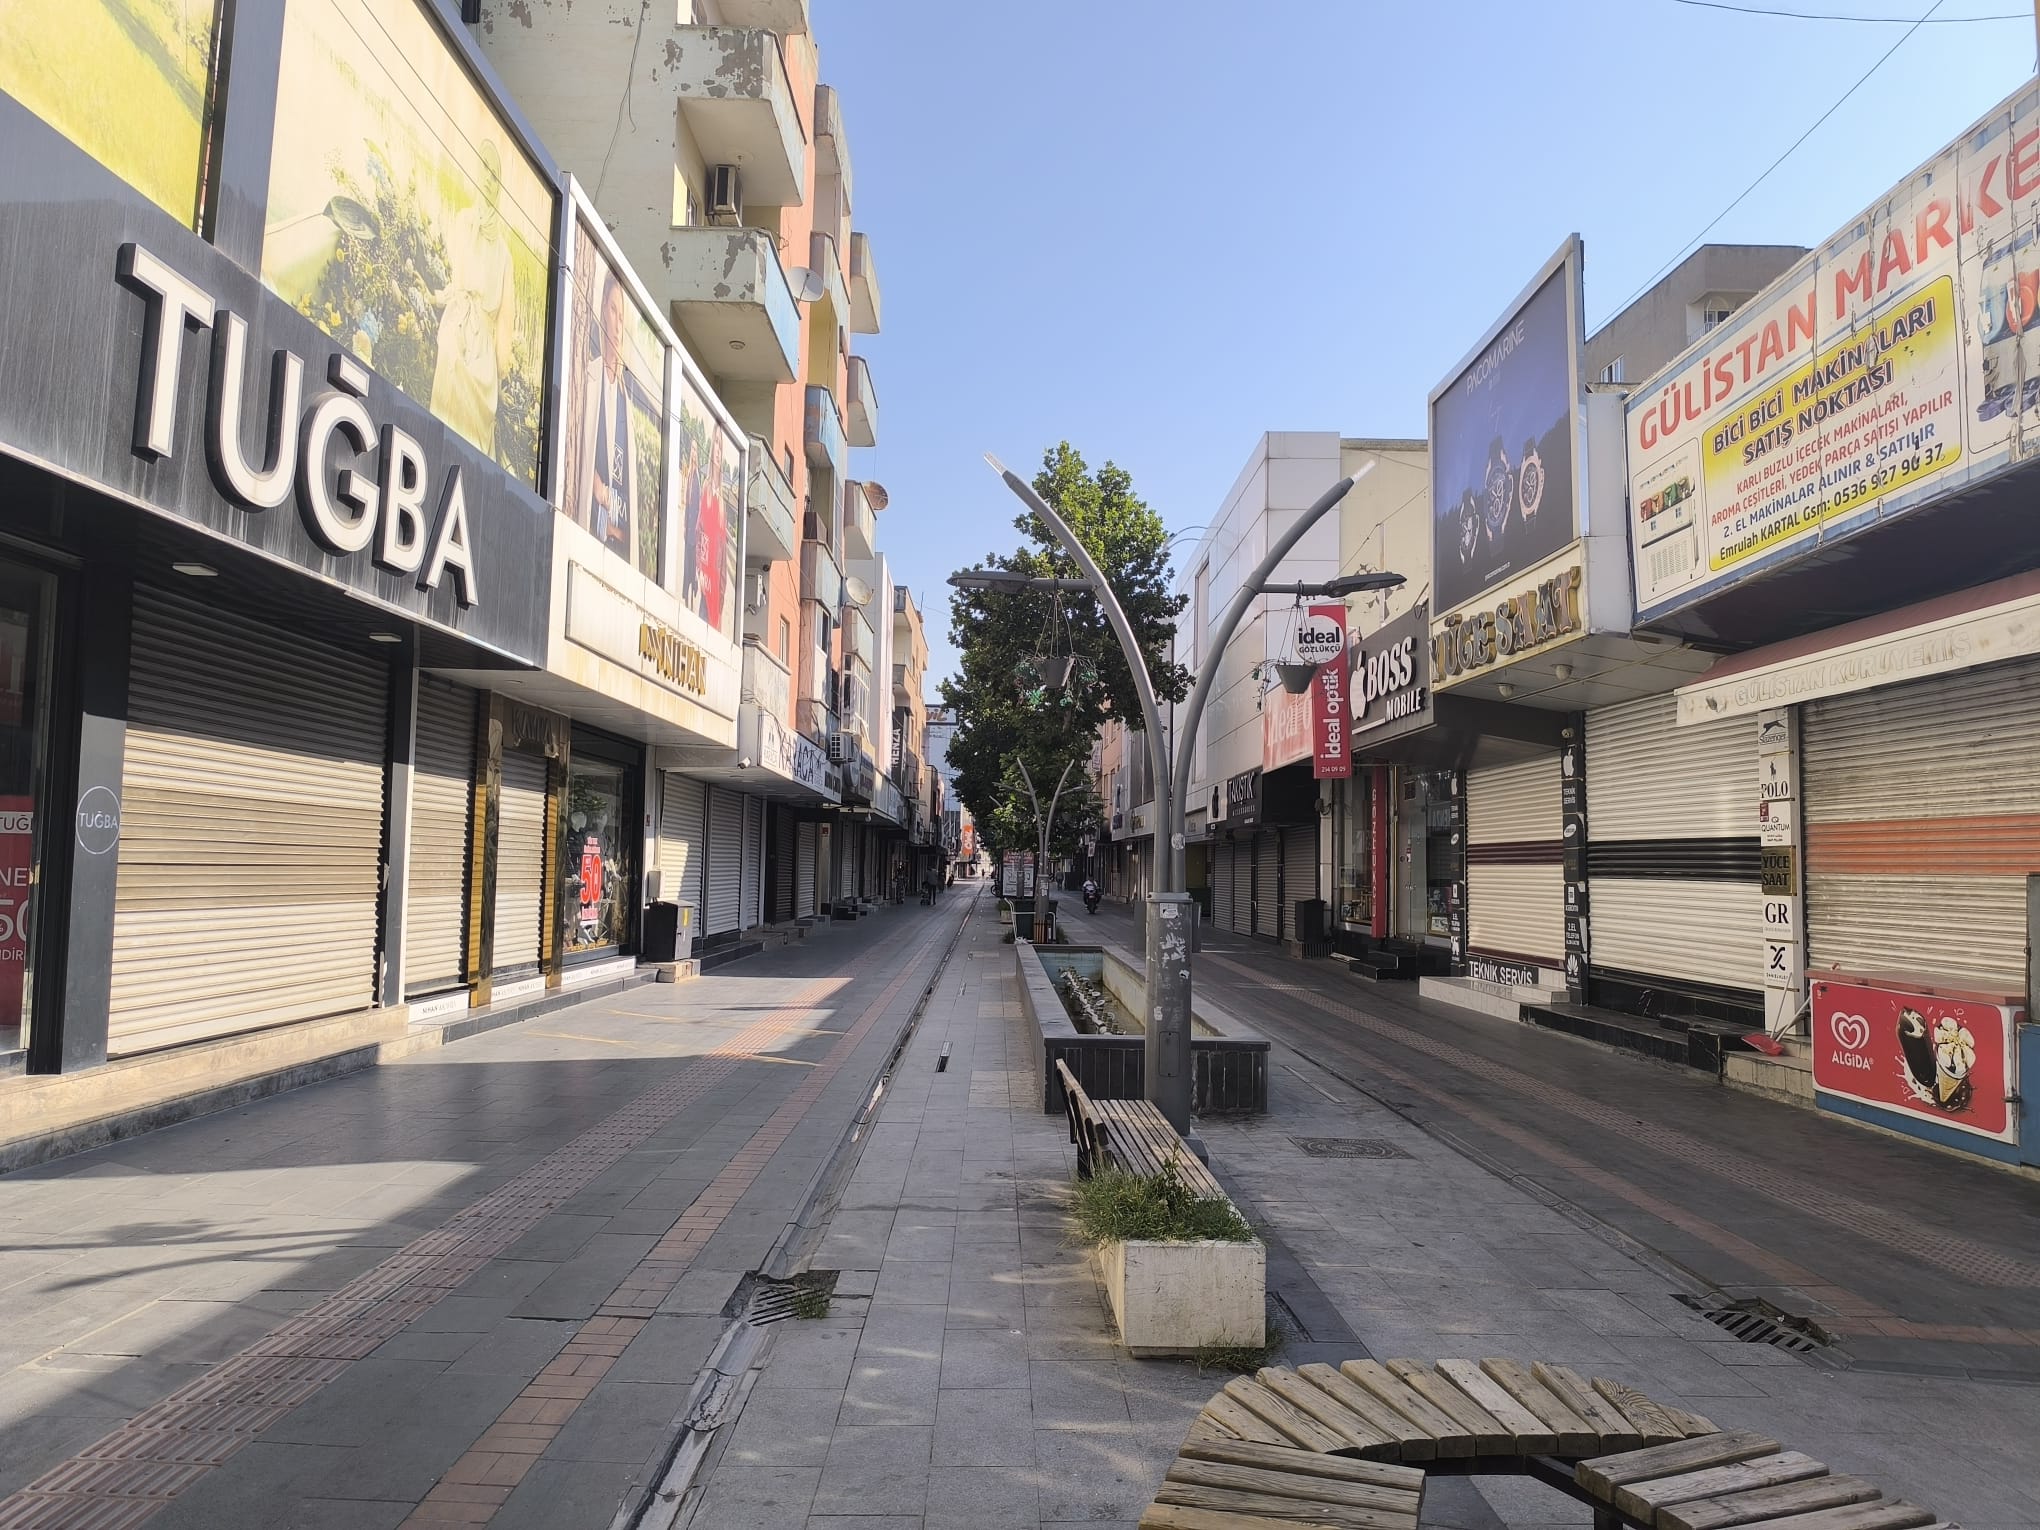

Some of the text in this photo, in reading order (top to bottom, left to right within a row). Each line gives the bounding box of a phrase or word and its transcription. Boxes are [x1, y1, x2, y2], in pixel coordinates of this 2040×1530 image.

[1466, 319, 1525, 397] PACOMARINE
[1640, 291, 1816, 450] GÜLİSTAN
[116, 243, 478, 607] TUĞBA
[1713, 415, 1745, 454] BİCİ
[1749, 388, 1783, 432] BİCİ
[1743, 359, 1893, 465] SATIŞ NOKTASI
[1711, 505, 1740, 526] AROMA
[1790, 463, 1822, 484] YEDEK
[1825, 441, 1861, 467] PARÇA
[1864, 418, 1898, 447] SATIŞI
[1903, 391, 1952, 424] YAPILIR
[1723, 423, 1935, 538] 2. EL MAKİNALAR ALINIR & SATILIR
[1737, 471, 1761, 494] KARLI
[1764, 457, 1793, 483] BUZLU
[1796, 437, 1830, 466] İÇECEK
[1720, 533, 1758, 560] Emrulah
[1760, 514, 1800, 541] KARTAL
[1803, 499, 1831, 520] Gsm:
[1834, 479, 1867, 507] 0536
[1925, 442, 1944, 468] 37
[1298, 626, 1340, 644] ideal
[1495, 566, 1581, 656] SAAT
[1300, 645, 1341, 654] GÖZLÜKÇÜ
[1366, 636, 1416, 702] BOSS
[1320, 668, 1344, 759] ideal optik
[1386, 687, 1425, 721] MOBILE
[79, 811, 118, 829] TUĞBA
[1761, 781, 1788, 799] POLO
[1762, 852, 1790, 869] YÜCE
[1762, 872, 1789, 887] SAAT
[1765, 903, 1789, 923] GR
[1469, 959, 1498, 983] TEKNİK
[1500, 966, 1533, 986] SERVİS
